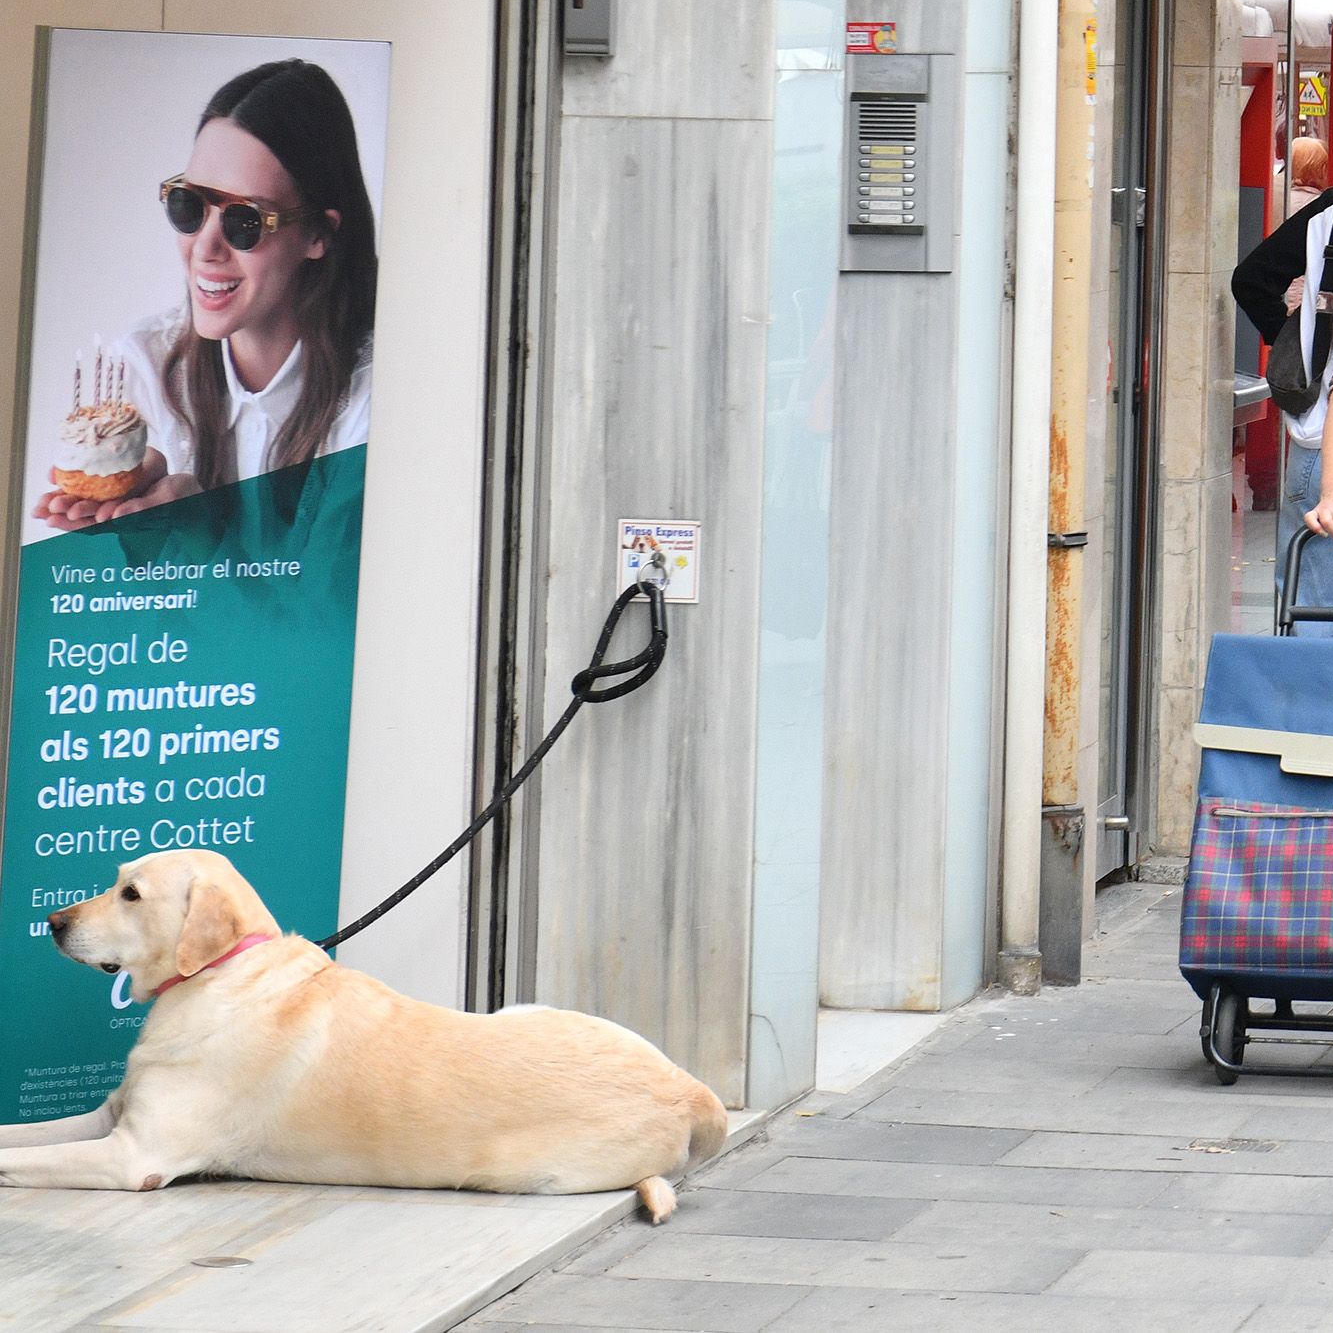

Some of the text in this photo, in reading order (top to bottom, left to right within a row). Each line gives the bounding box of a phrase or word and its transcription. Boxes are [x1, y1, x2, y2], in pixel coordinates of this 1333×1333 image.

[656, 527, 694, 538] Express
[51, 558, 301, 585] Vine a celebrar el nostre
[51, 589, 197, 615] 120 aniversari!
[47, 632, 188, 675] Regal de
[45, 680, 256, 716] 120 muntures
[40, 724, 280, 765] als 120 primers
[37, 767, 266, 810] clients a cada
[34, 815, 256, 858] centre Cottet
[31, 886, 86, 909] Entra
[101, 1074, 124, 1084] unita
